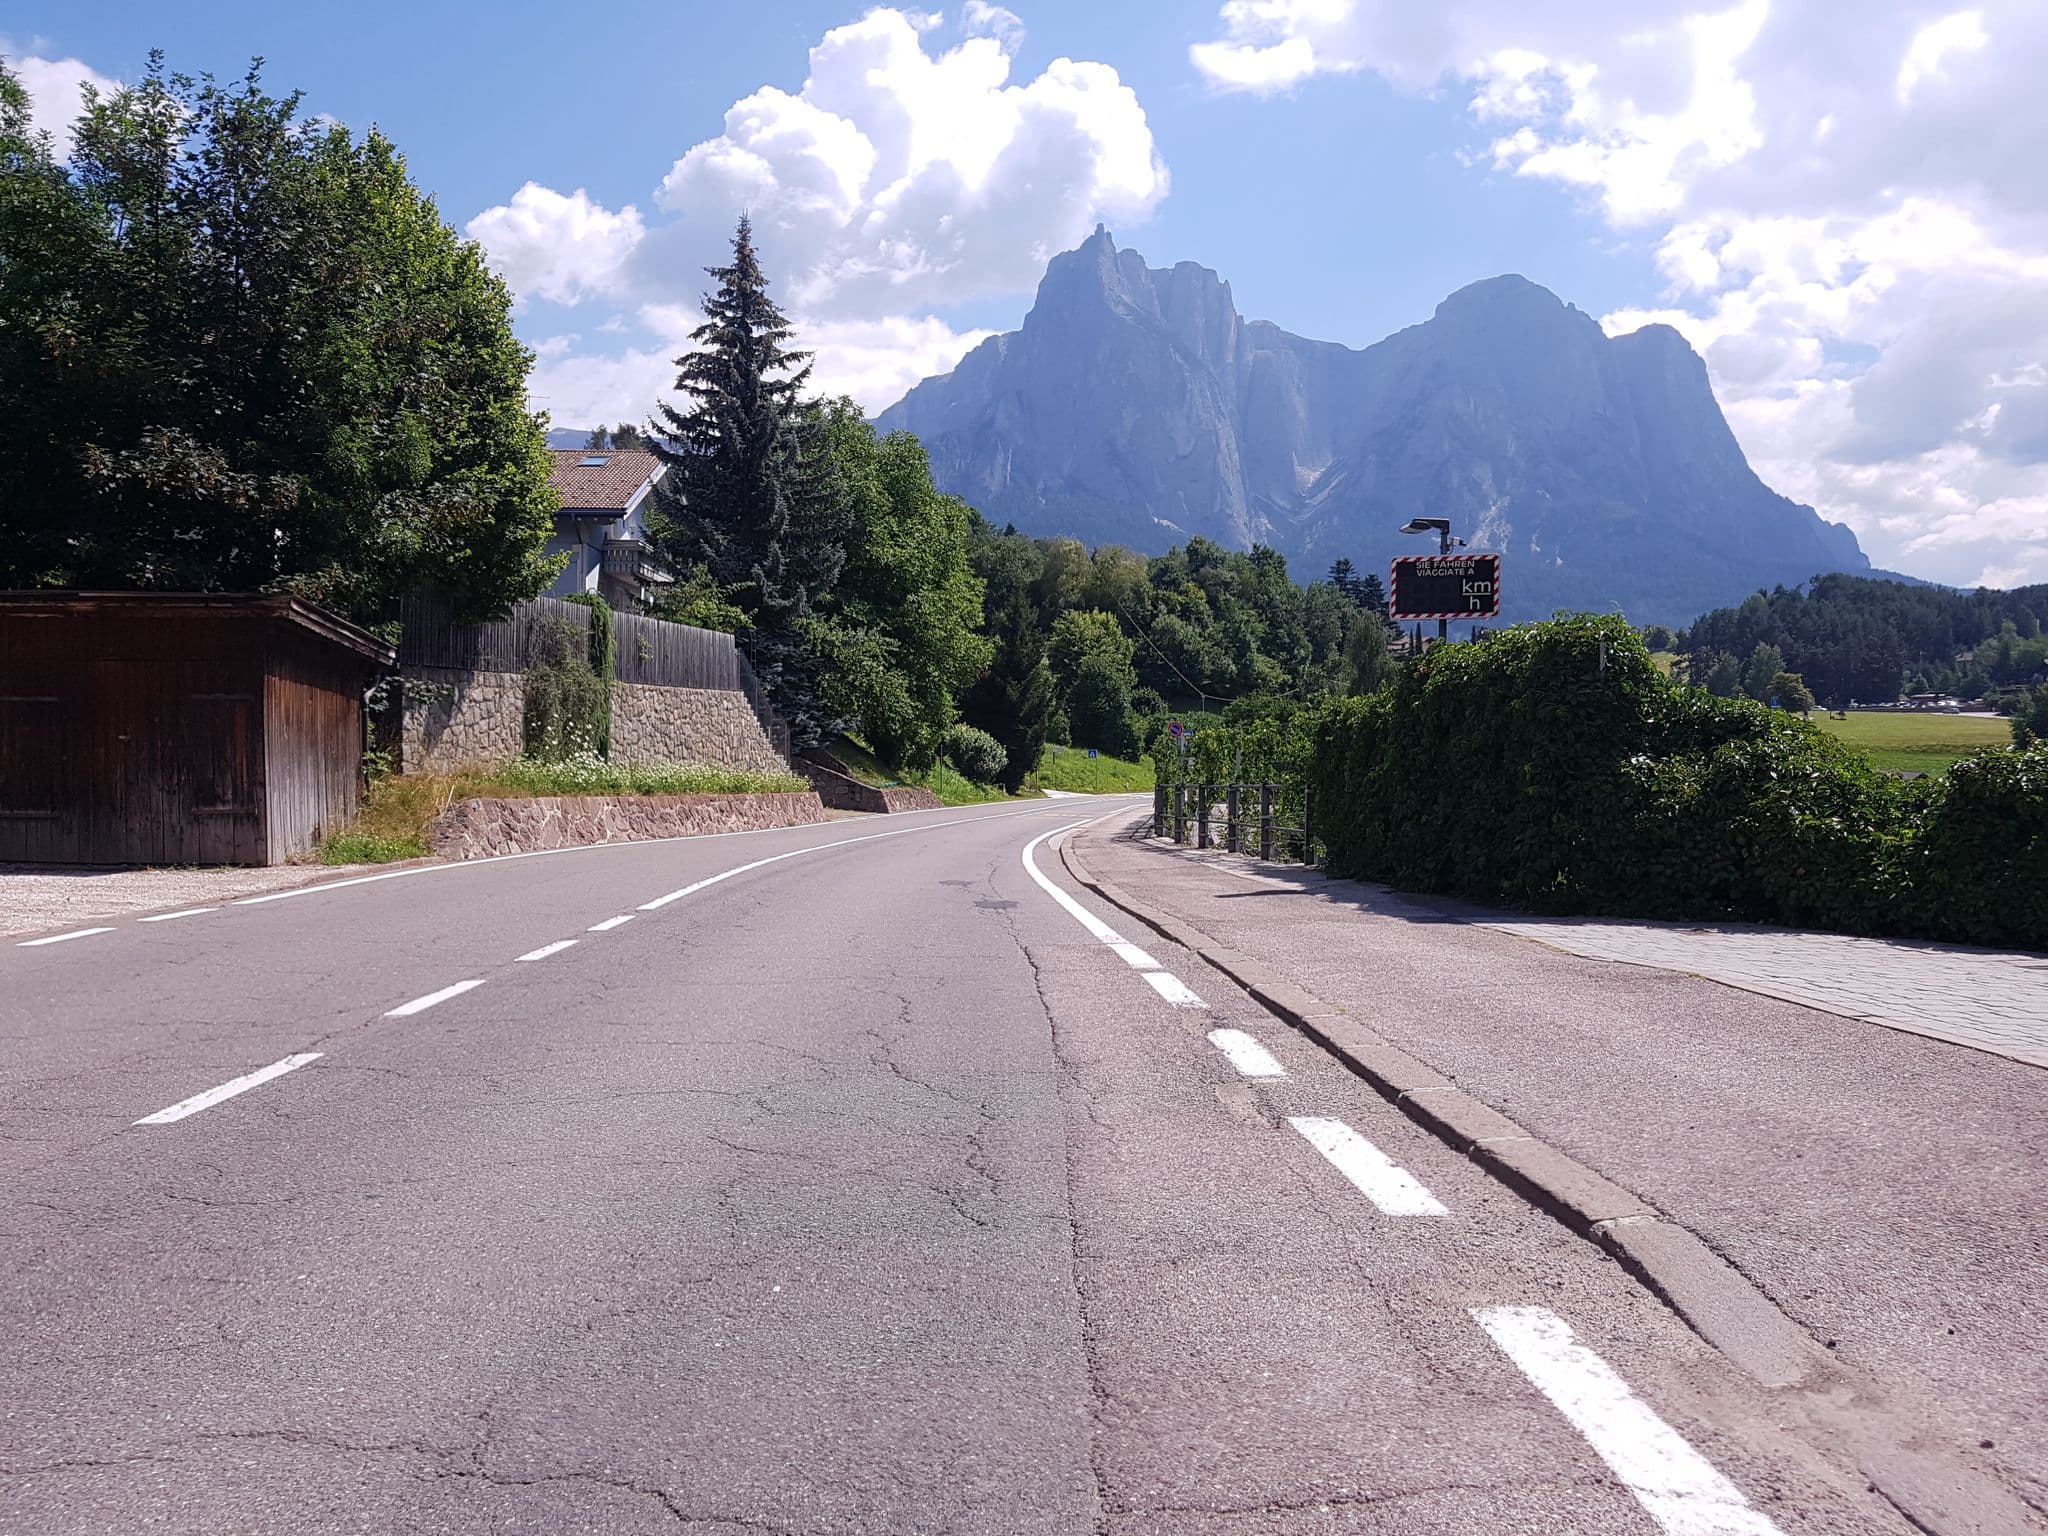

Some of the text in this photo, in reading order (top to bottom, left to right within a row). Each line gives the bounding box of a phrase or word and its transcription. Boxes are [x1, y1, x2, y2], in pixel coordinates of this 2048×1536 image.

[1416, 560, 1475, 569] SIE FAHREN
[1416, 568, 1465, 577] VIAGGIATE
[1462, 578, 1491, 593] km
[1469, 596, 1480, 610] h
